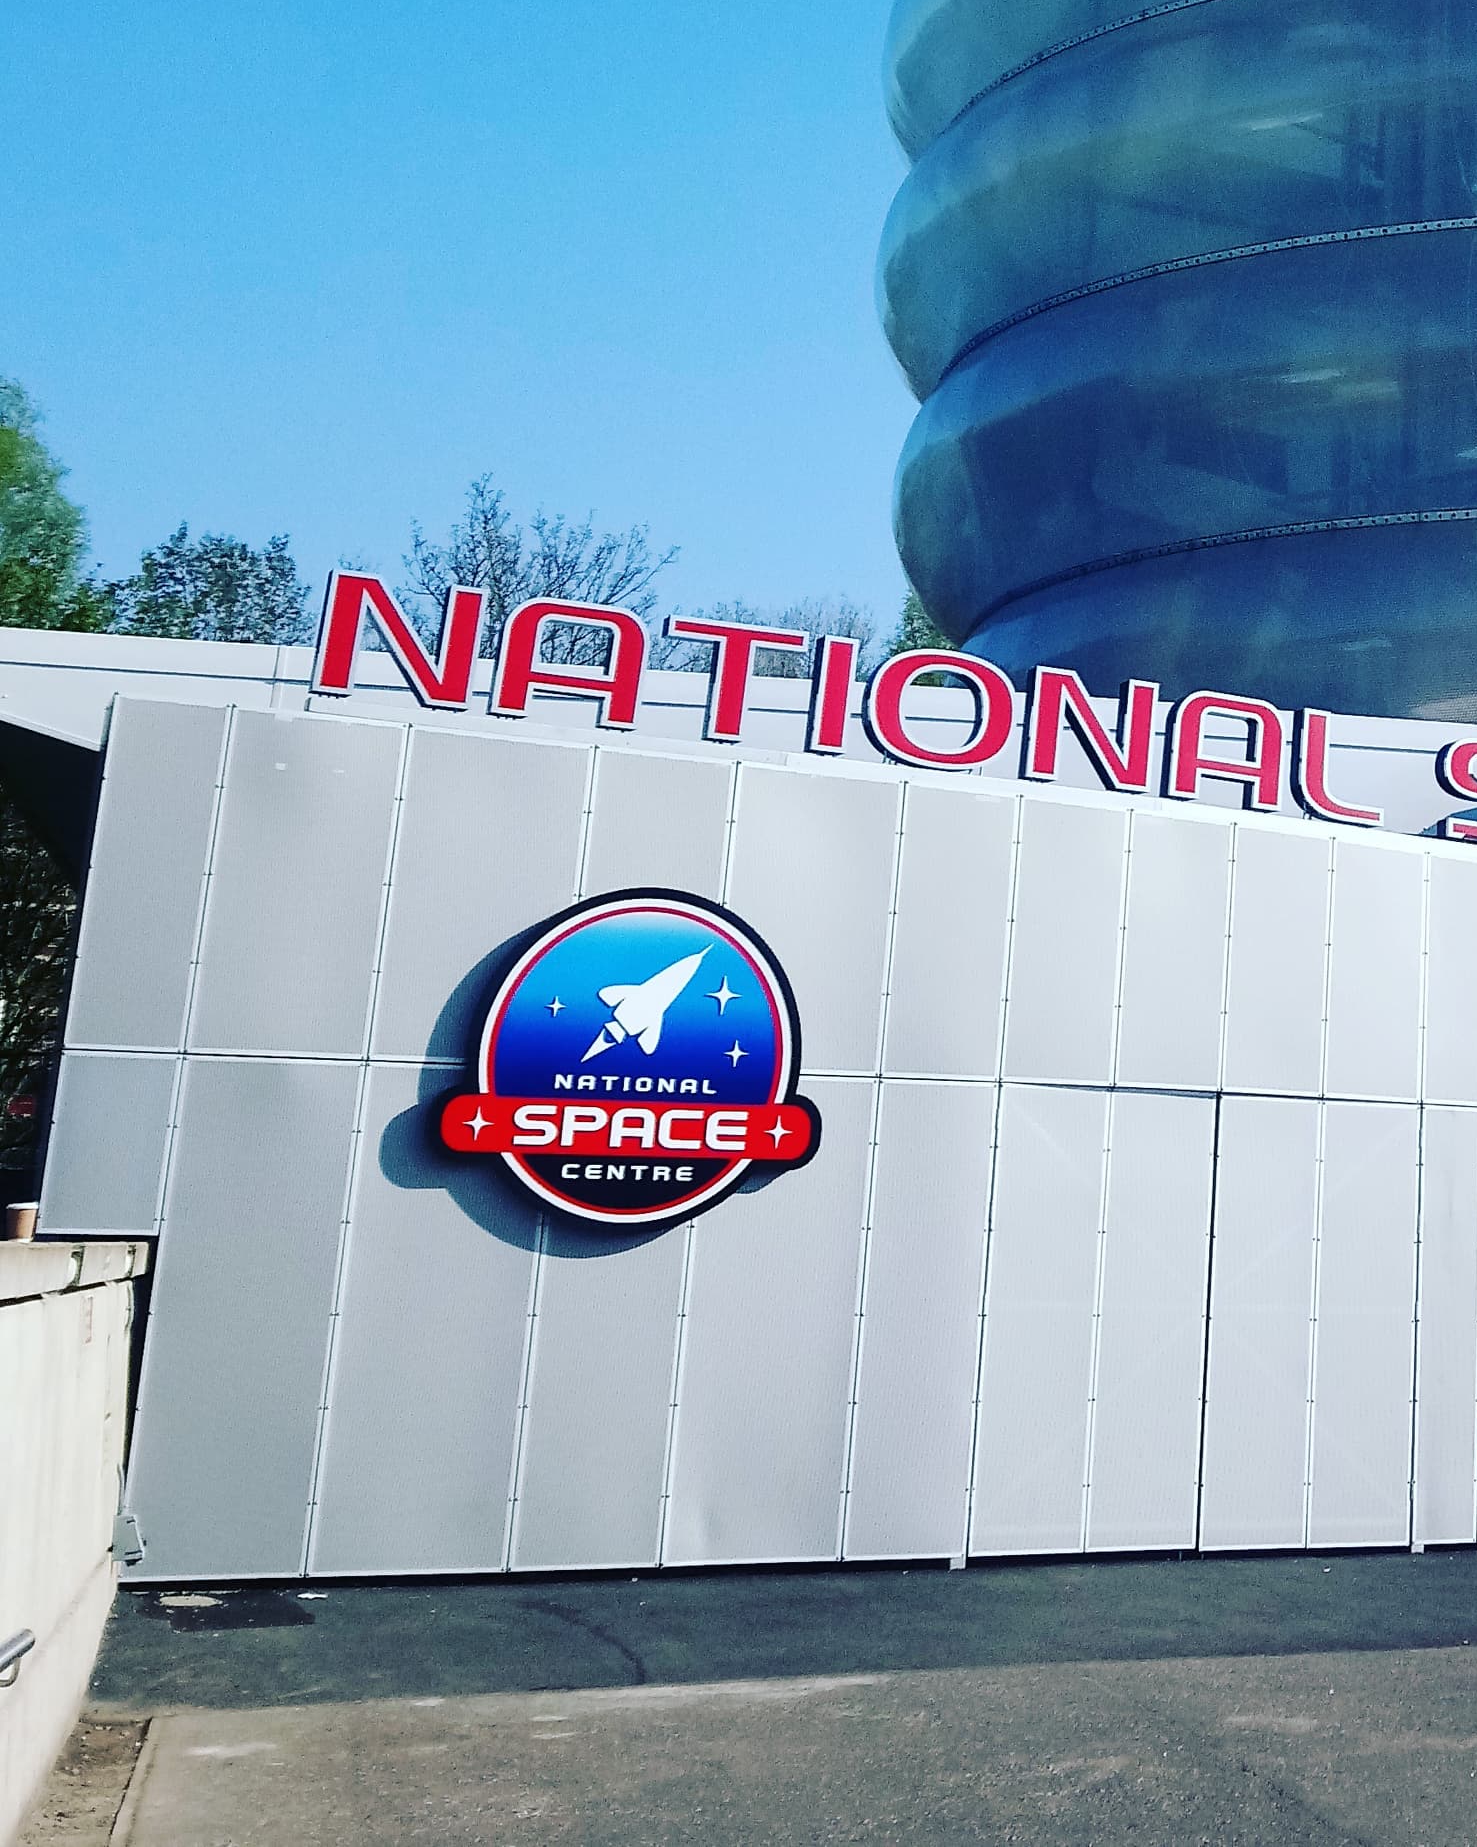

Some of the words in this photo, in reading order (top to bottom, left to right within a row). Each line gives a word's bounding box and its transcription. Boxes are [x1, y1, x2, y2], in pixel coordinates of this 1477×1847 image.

[311, 568, 1385, 827] NATIONAL
[554, 1073, 718, 1095] NATIONAL
[512, 1104, 750, 1151] SPACE
[560, 1163, 695, 1182] CENTRE
